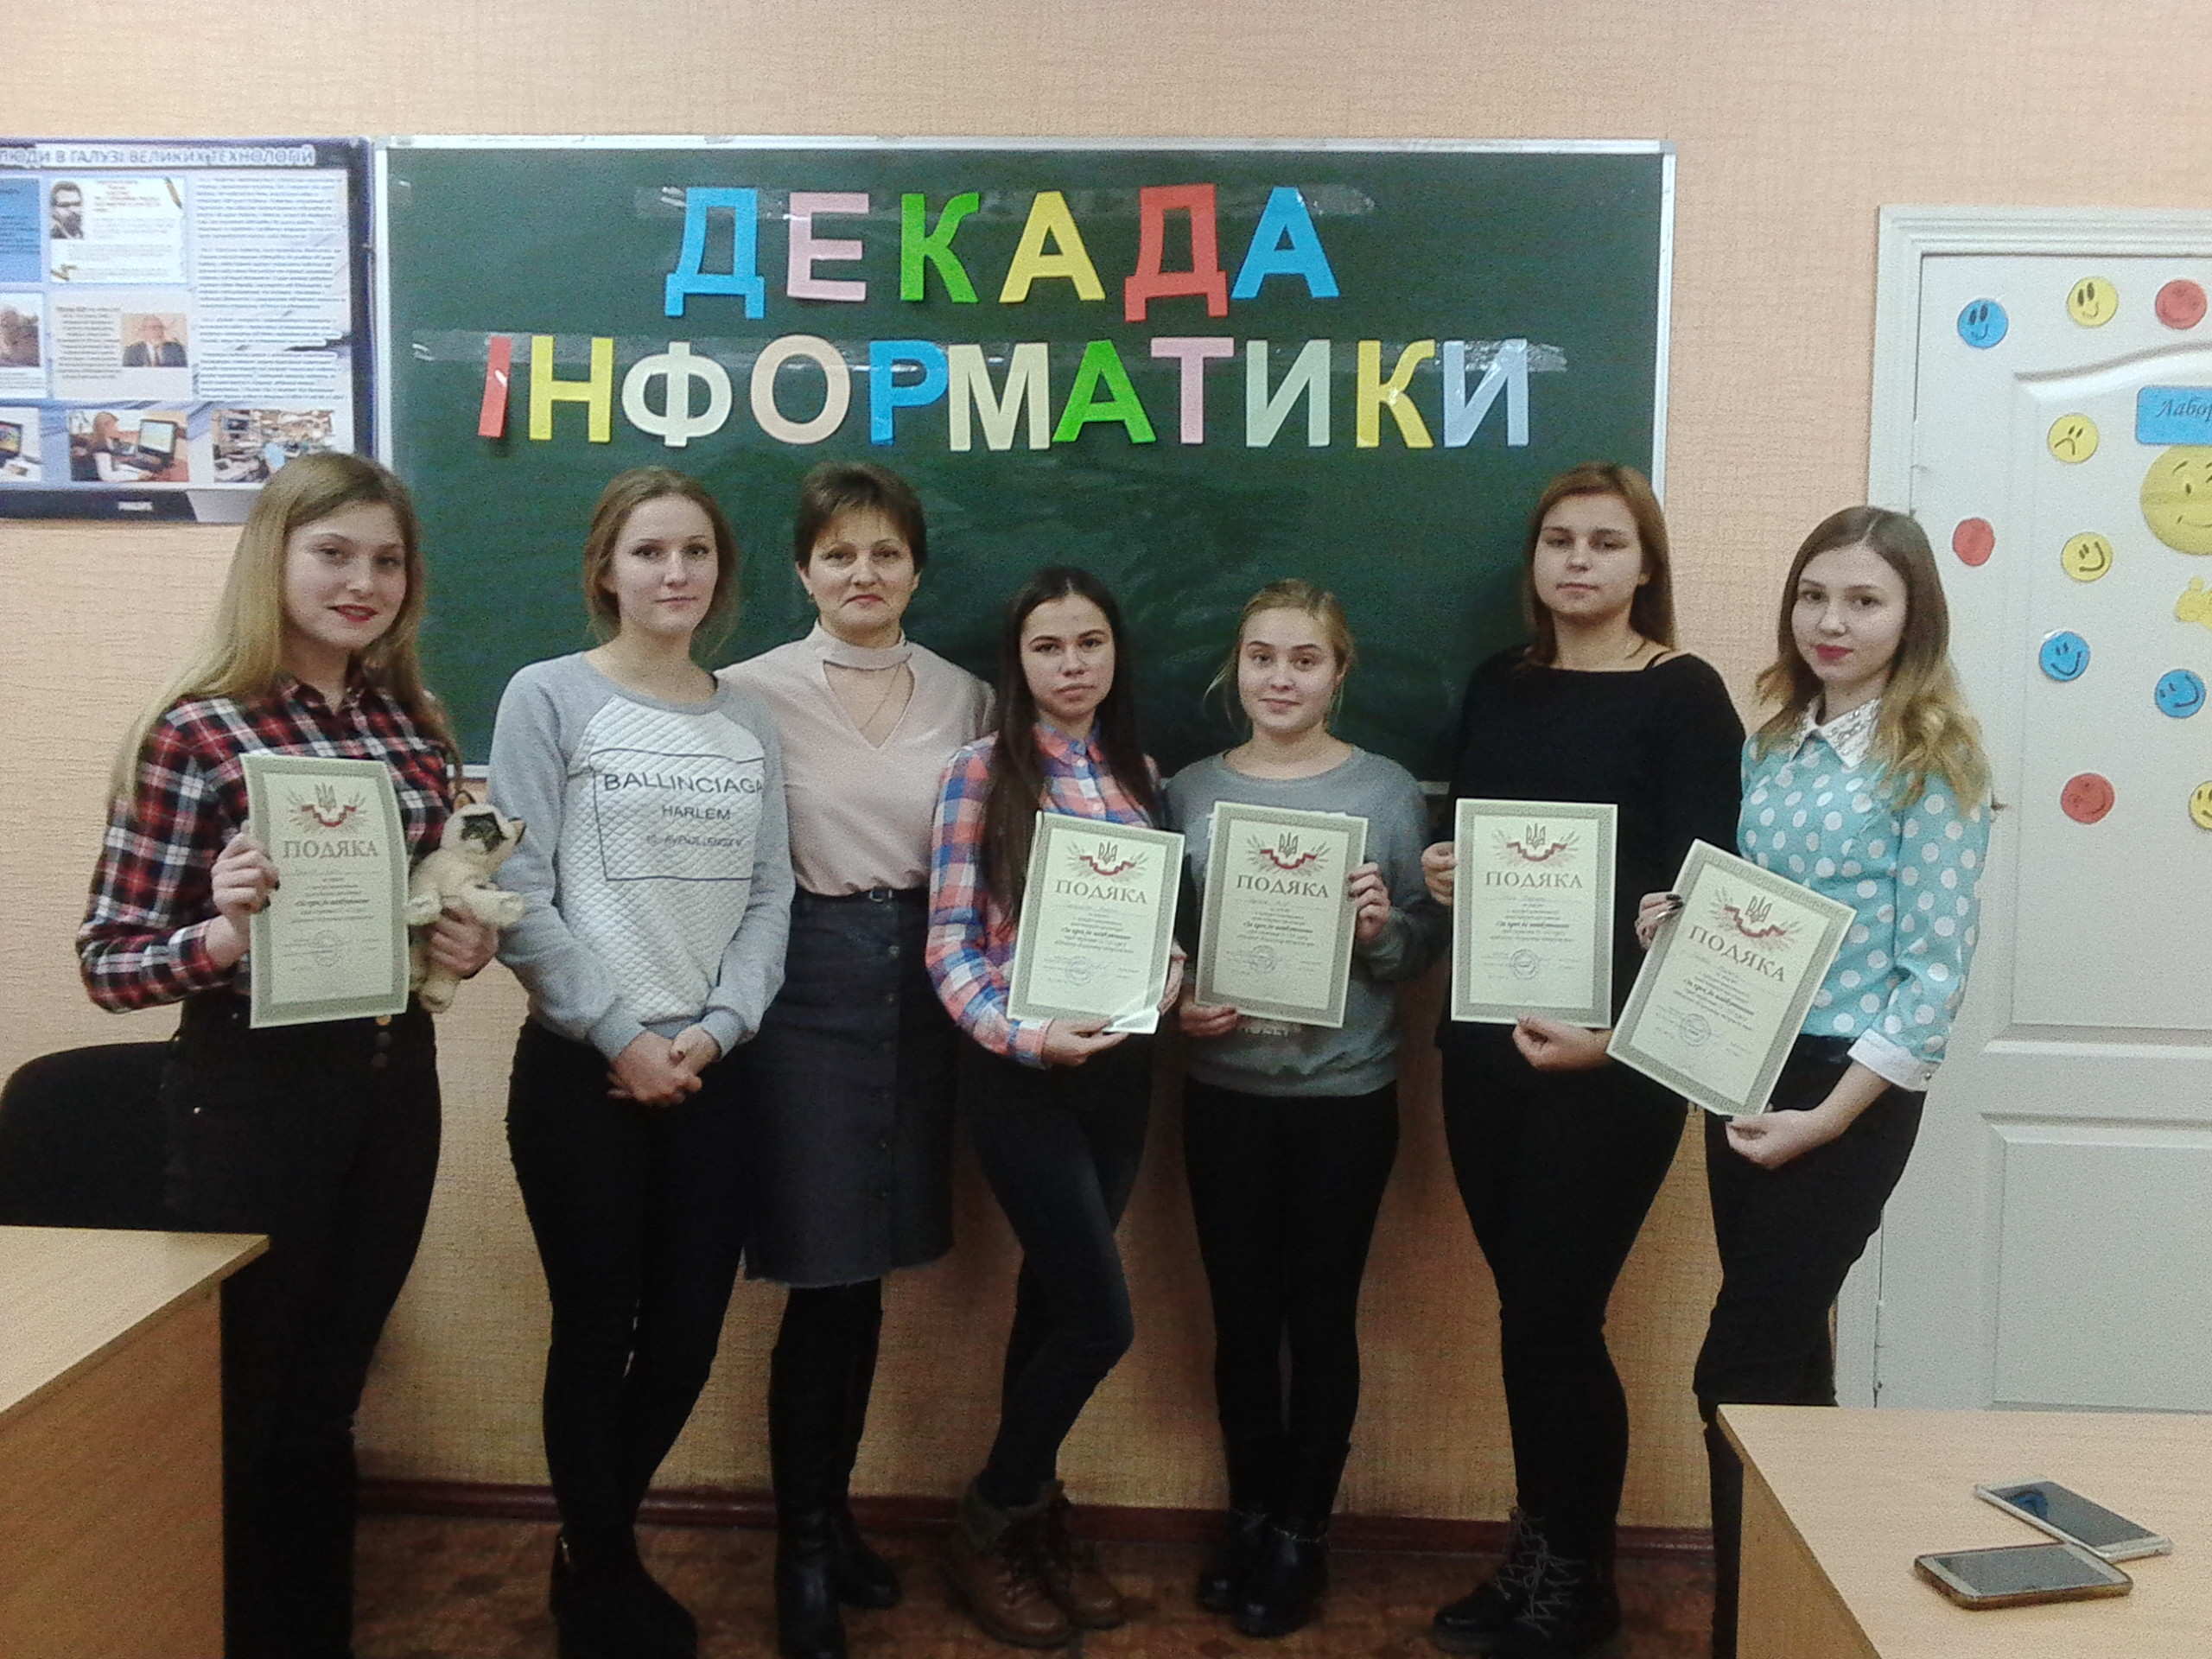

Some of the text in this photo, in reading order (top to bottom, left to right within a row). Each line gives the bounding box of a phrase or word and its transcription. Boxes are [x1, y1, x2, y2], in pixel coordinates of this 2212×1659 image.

[664, 183, 1339, 321] ДЕКАДА
[478, 336, 1530, 452] ІНФОРМАТИКИ
[662, 804, 731, 821] HARLEM
[283, 839, 378, 859] ПОДЯКА
[1236, 874, 1329, 898] ПОДЯКА
[1485, 871, 1583, 888] ПОДЯКА
[1055, 880, 1147, 904] ПОДЯКА
[1688, 925, 1786, 983] ПОДЯКА
